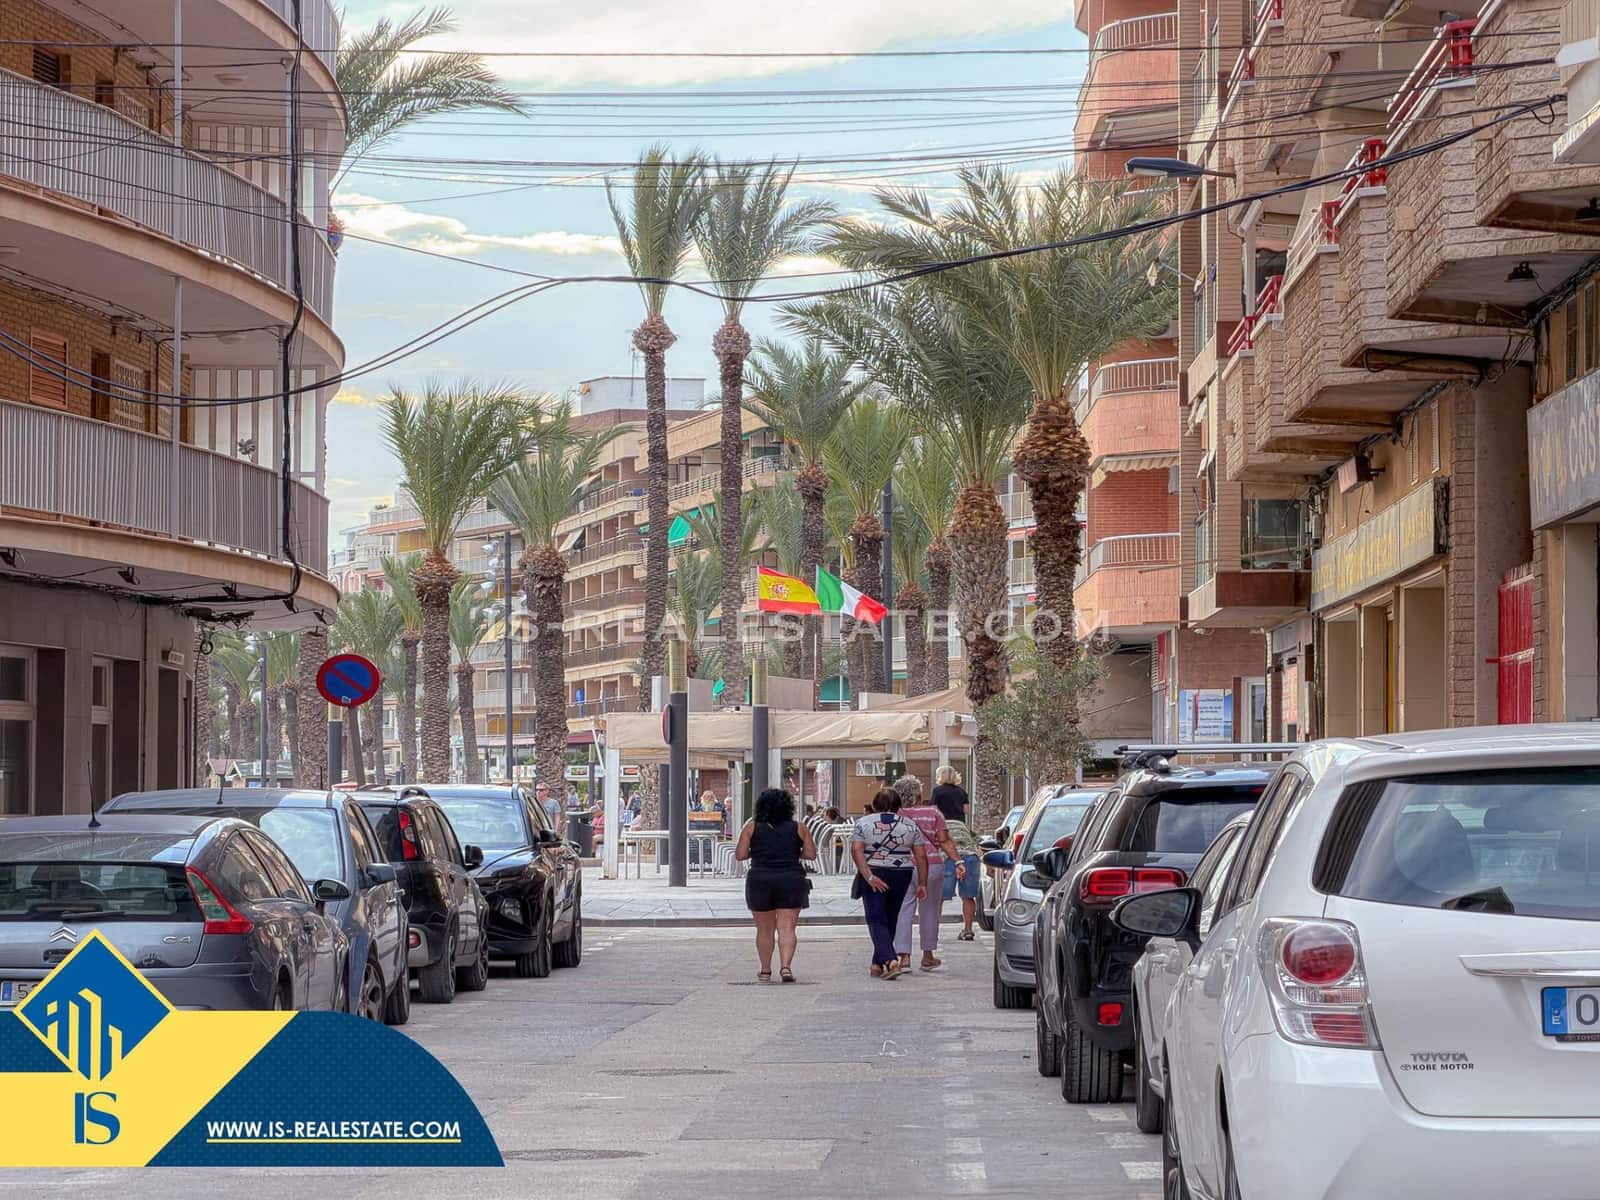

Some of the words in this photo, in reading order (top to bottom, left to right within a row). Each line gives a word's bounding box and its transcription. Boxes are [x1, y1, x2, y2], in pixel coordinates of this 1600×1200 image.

[163, 935, 192, 944] C4
[1410, 1052, 1468, 1062] TOYOTA
[1412, 1063, 1437, 1071] KOBE
[1440, 1062, 1474, 1071] MOTOR
